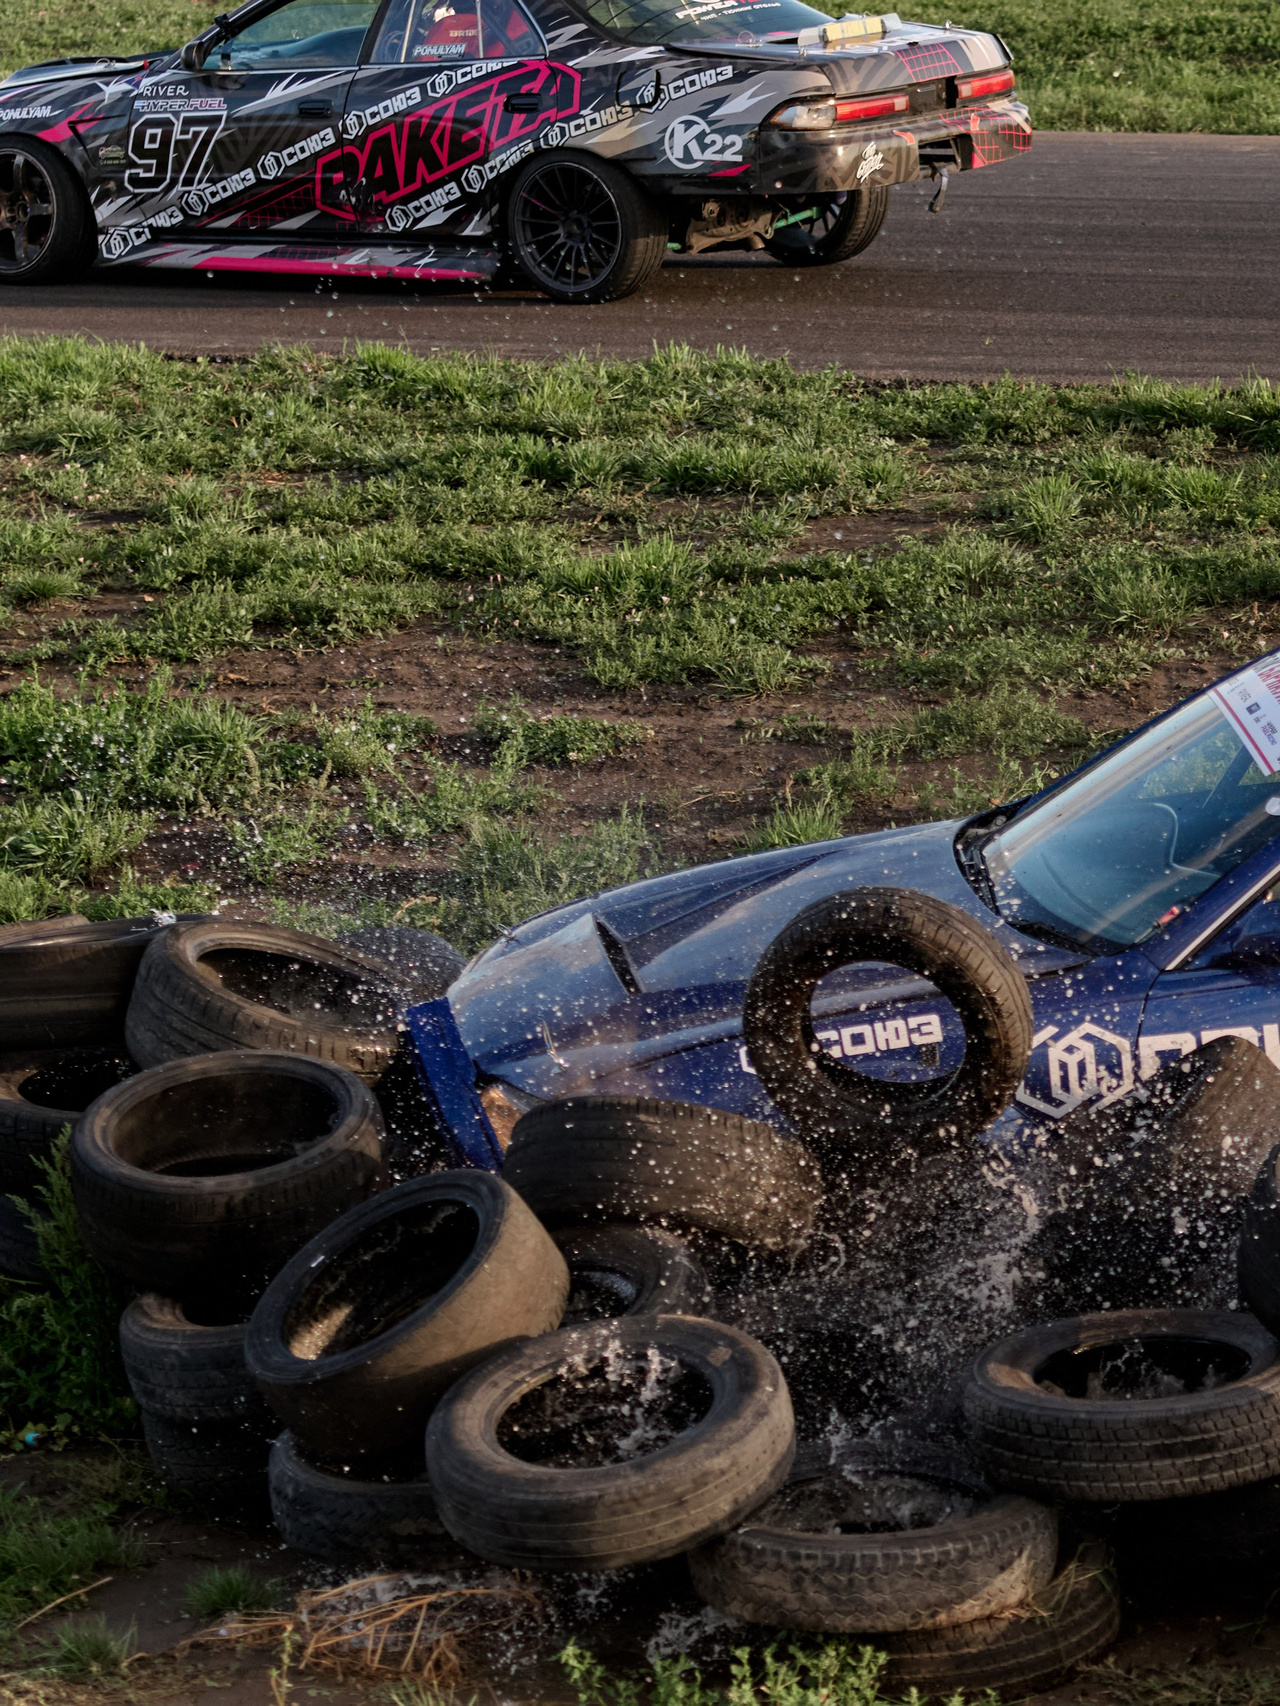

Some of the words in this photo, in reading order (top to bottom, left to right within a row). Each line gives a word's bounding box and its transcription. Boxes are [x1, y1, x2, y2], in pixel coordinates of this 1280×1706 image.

[413, 43, 466, 57] PONULYAM
[142, 85, 190, 98] RIVER
[668, 65, 734, 100] СОЮЗ
[366, 86, 422, 125] СОЮЗ
[570, 100, 634, 138] СОЮЗ
[124, 110, 228, 193] 97
[282, 127, 337, 167] СОЮЗ
[206, 168, 257, 205] СОЮЗ
[410, 182, 462, 217] СОЮЗ
